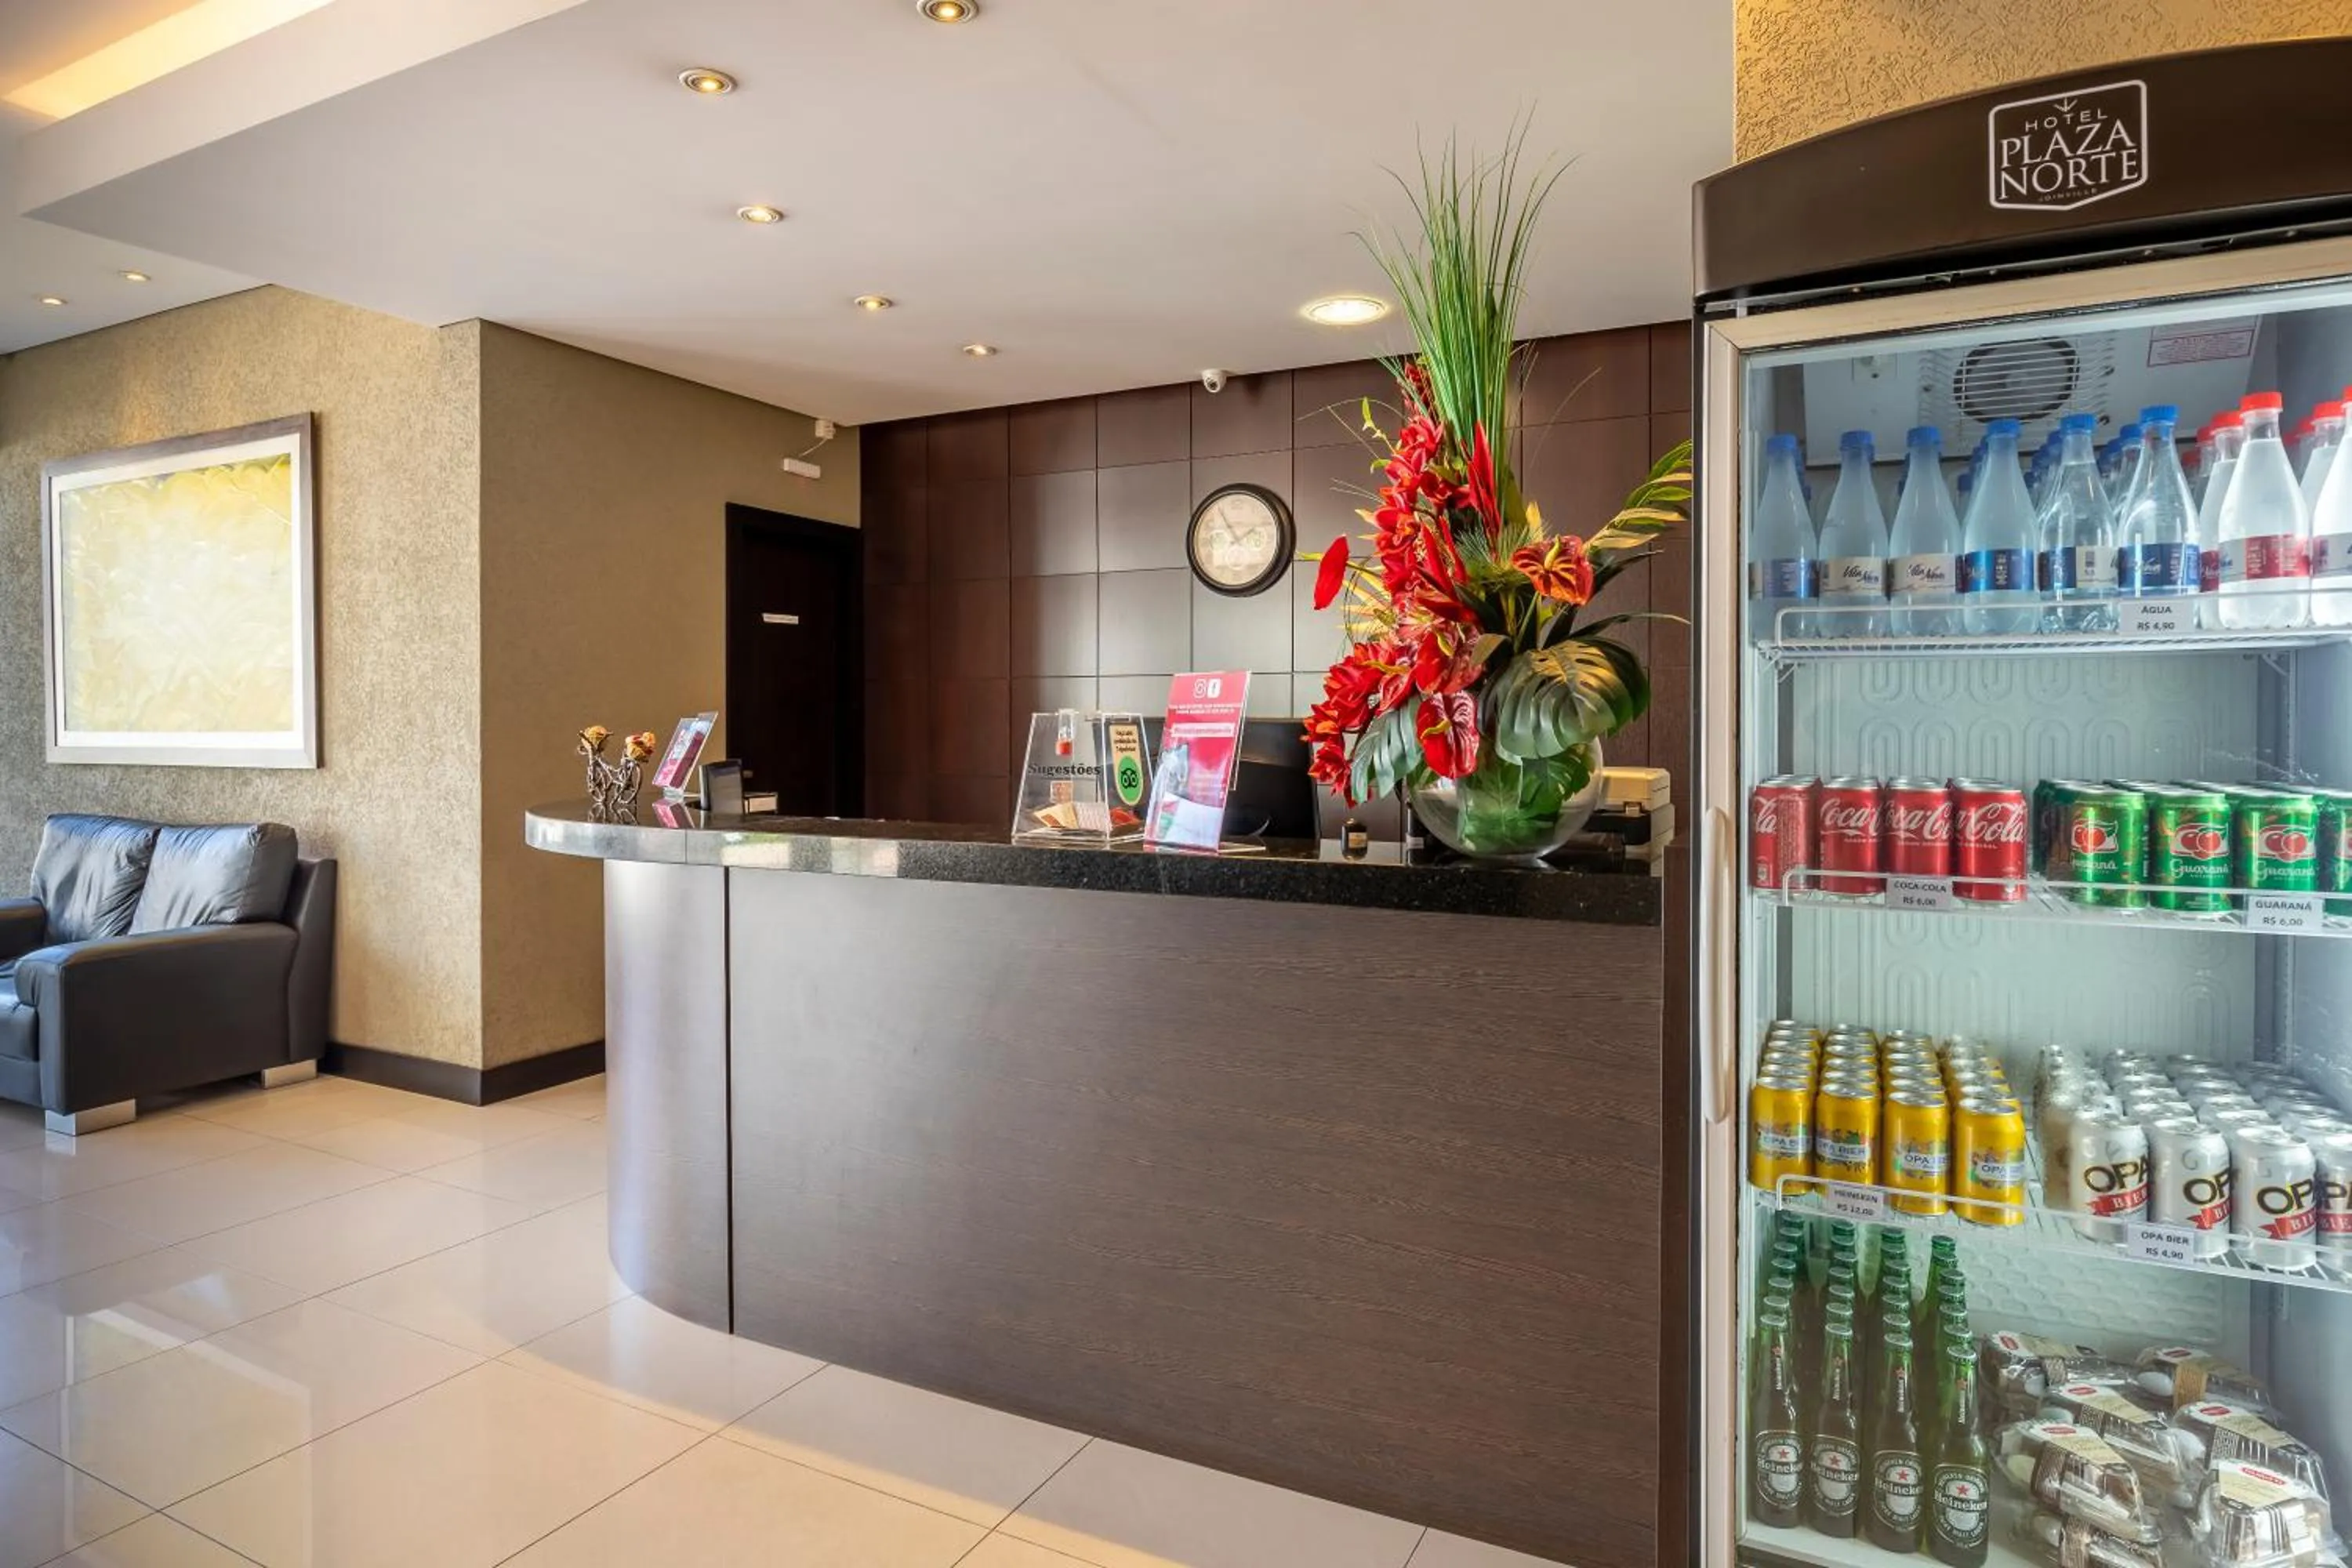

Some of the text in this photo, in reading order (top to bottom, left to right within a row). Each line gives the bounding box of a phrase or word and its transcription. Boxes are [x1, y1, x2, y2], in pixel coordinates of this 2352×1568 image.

[2025, 108, 2107, 131] HOTEL
[2000, 119, 2136, 169] PLAZA
[1999, 149, 2138, 200] NORTE
[1028, 763, 1102, 776] Sugestões
[2170, 859, 2229, 879] Guaraná
[2255, 860, 2316, 880] Guaraná
[2280, 917, 2303, 927] 6,00
[1904, 1154, 1929, 1164] OPA
[2183, 1167, 2230, 1204] OP
[2256, 1178, 2314, 1214] OP
[2141, 1231, 2190, 1245] OPA BIER
[1875, 1477, 1923, 1495] Heineke
